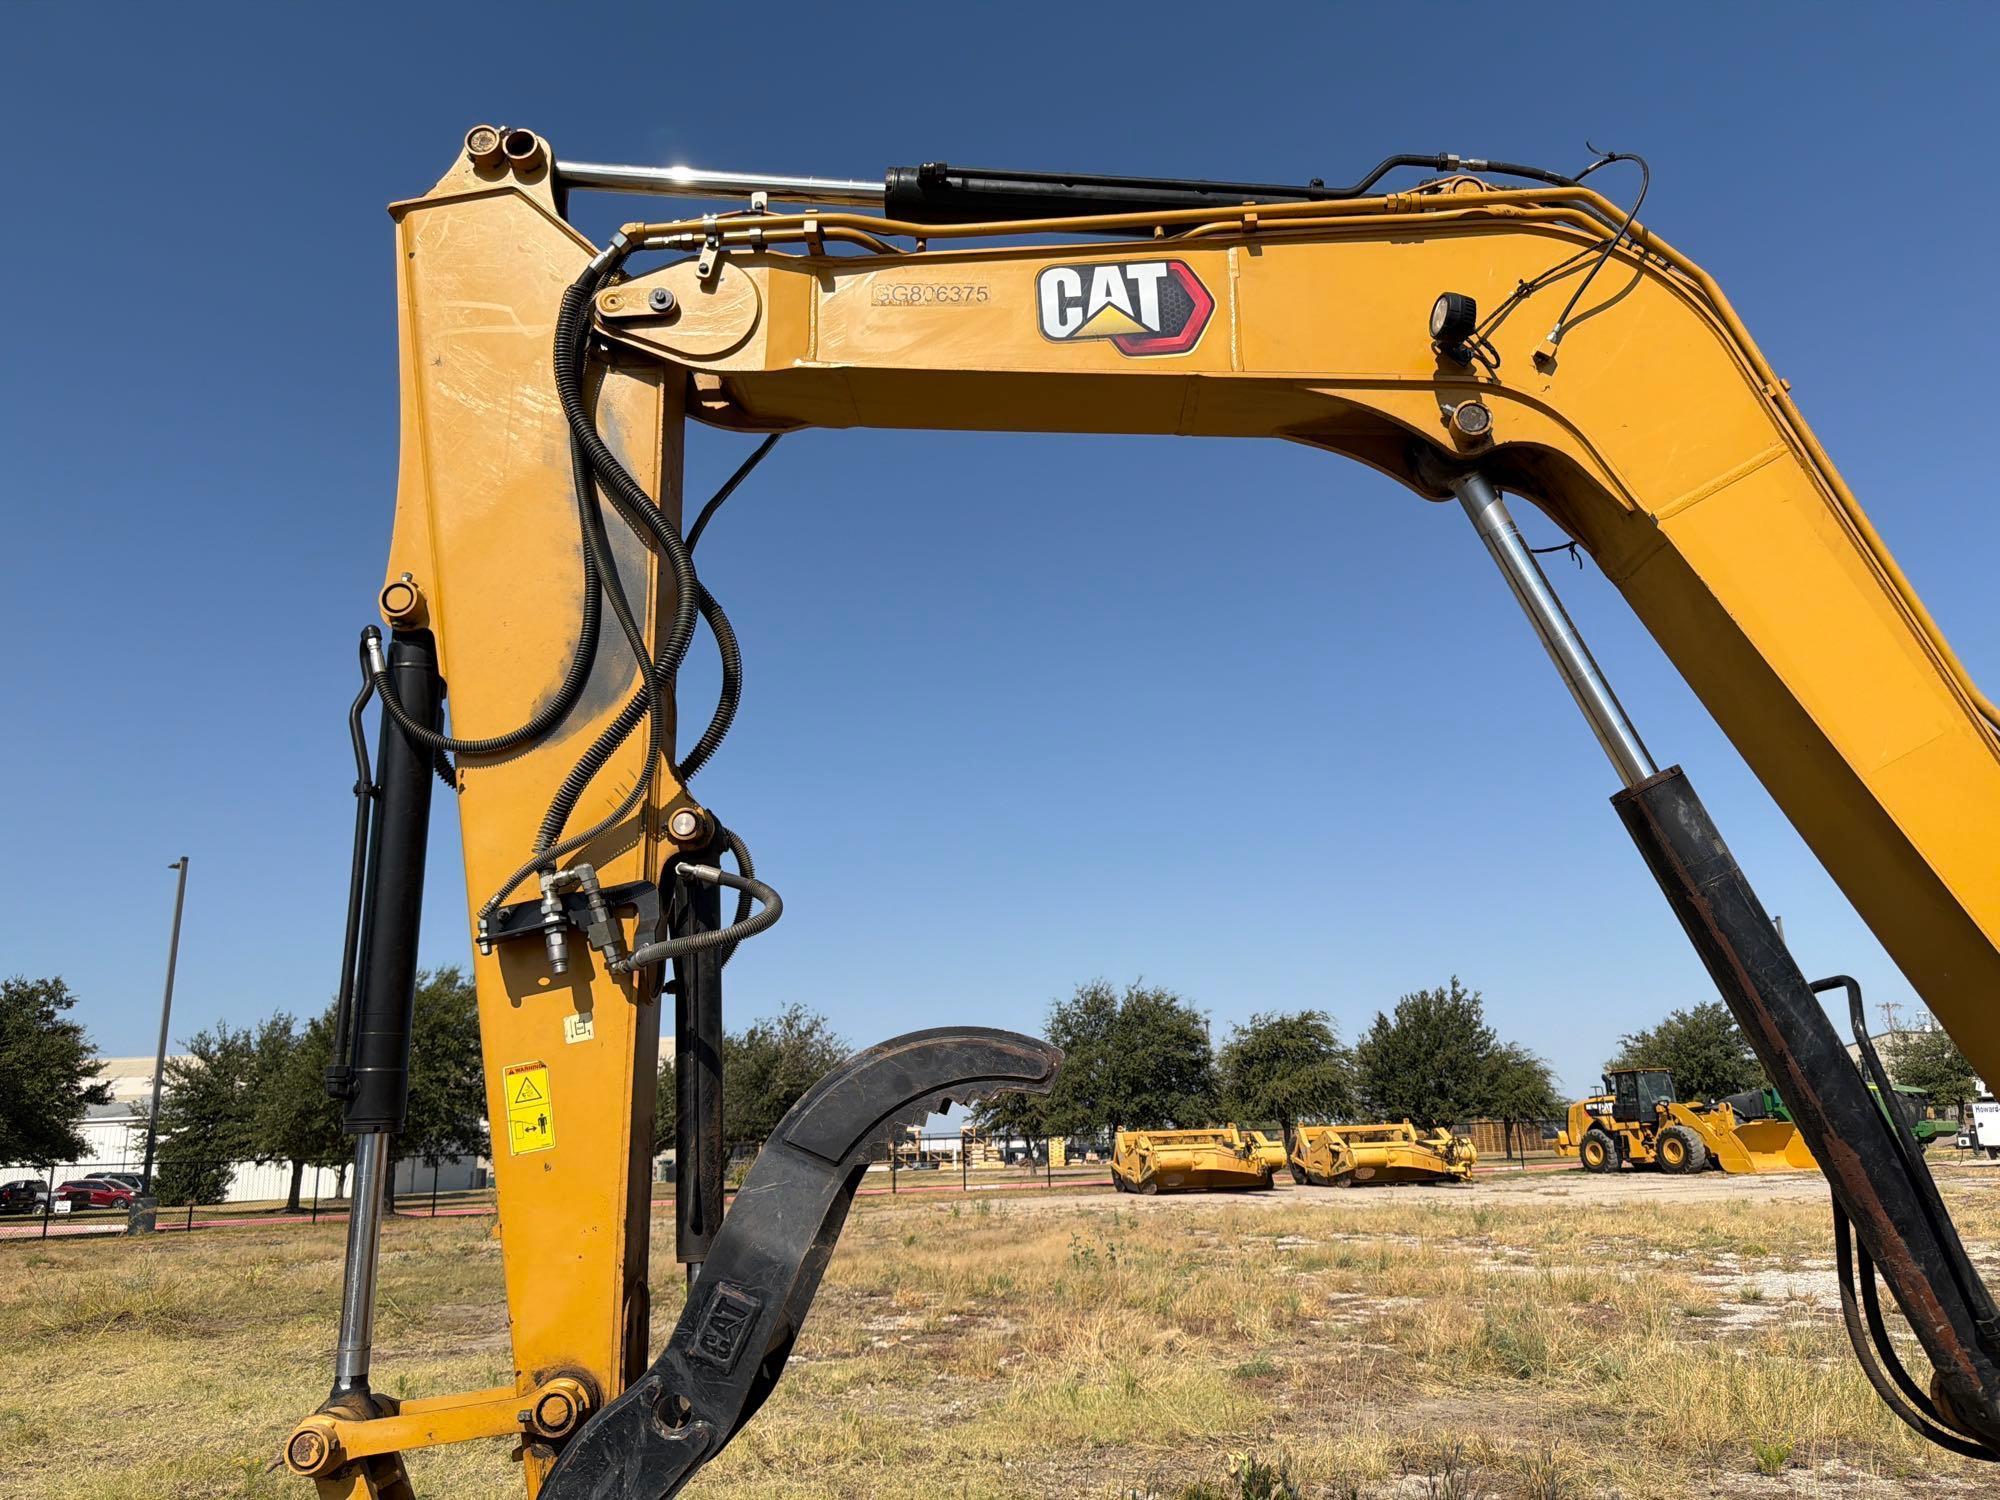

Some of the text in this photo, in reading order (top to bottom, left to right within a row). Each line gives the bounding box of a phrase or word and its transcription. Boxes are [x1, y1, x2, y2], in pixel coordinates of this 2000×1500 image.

[1040, 262, 1168, 338] CAT
[1598, 1102, 1614, 1115] CAT
[699, 1296, 750, 1360] CAT
